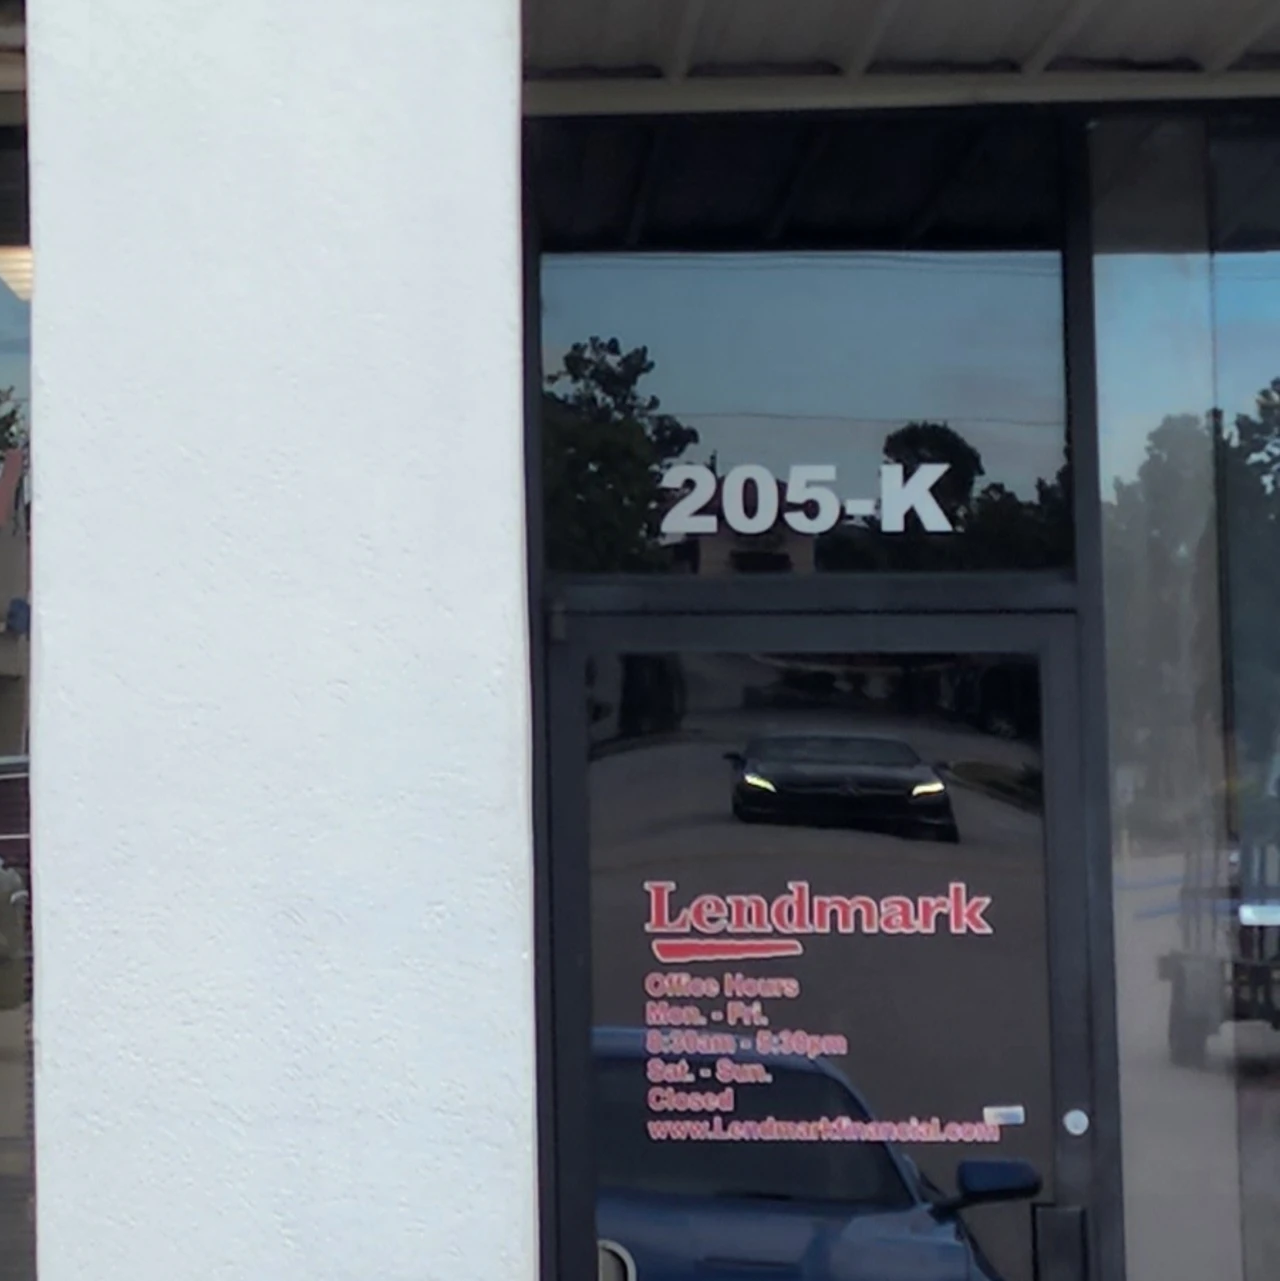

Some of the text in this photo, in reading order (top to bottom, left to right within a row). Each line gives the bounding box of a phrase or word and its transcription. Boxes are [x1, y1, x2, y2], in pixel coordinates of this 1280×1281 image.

[659, 463, 953, 534] 205-K
[644, 881, 993, 934] Lendmark
[645, 972, 800, 998] Office Hours
[646, 1001, 707, 1026] Mon.
[727, 1000, 769, 1026] Fri.
[646, 1057, 695, 1083] Sat.
[716, 1057, 773, 1083] Sun.
[648, 1086, 734, 1112] Closed
